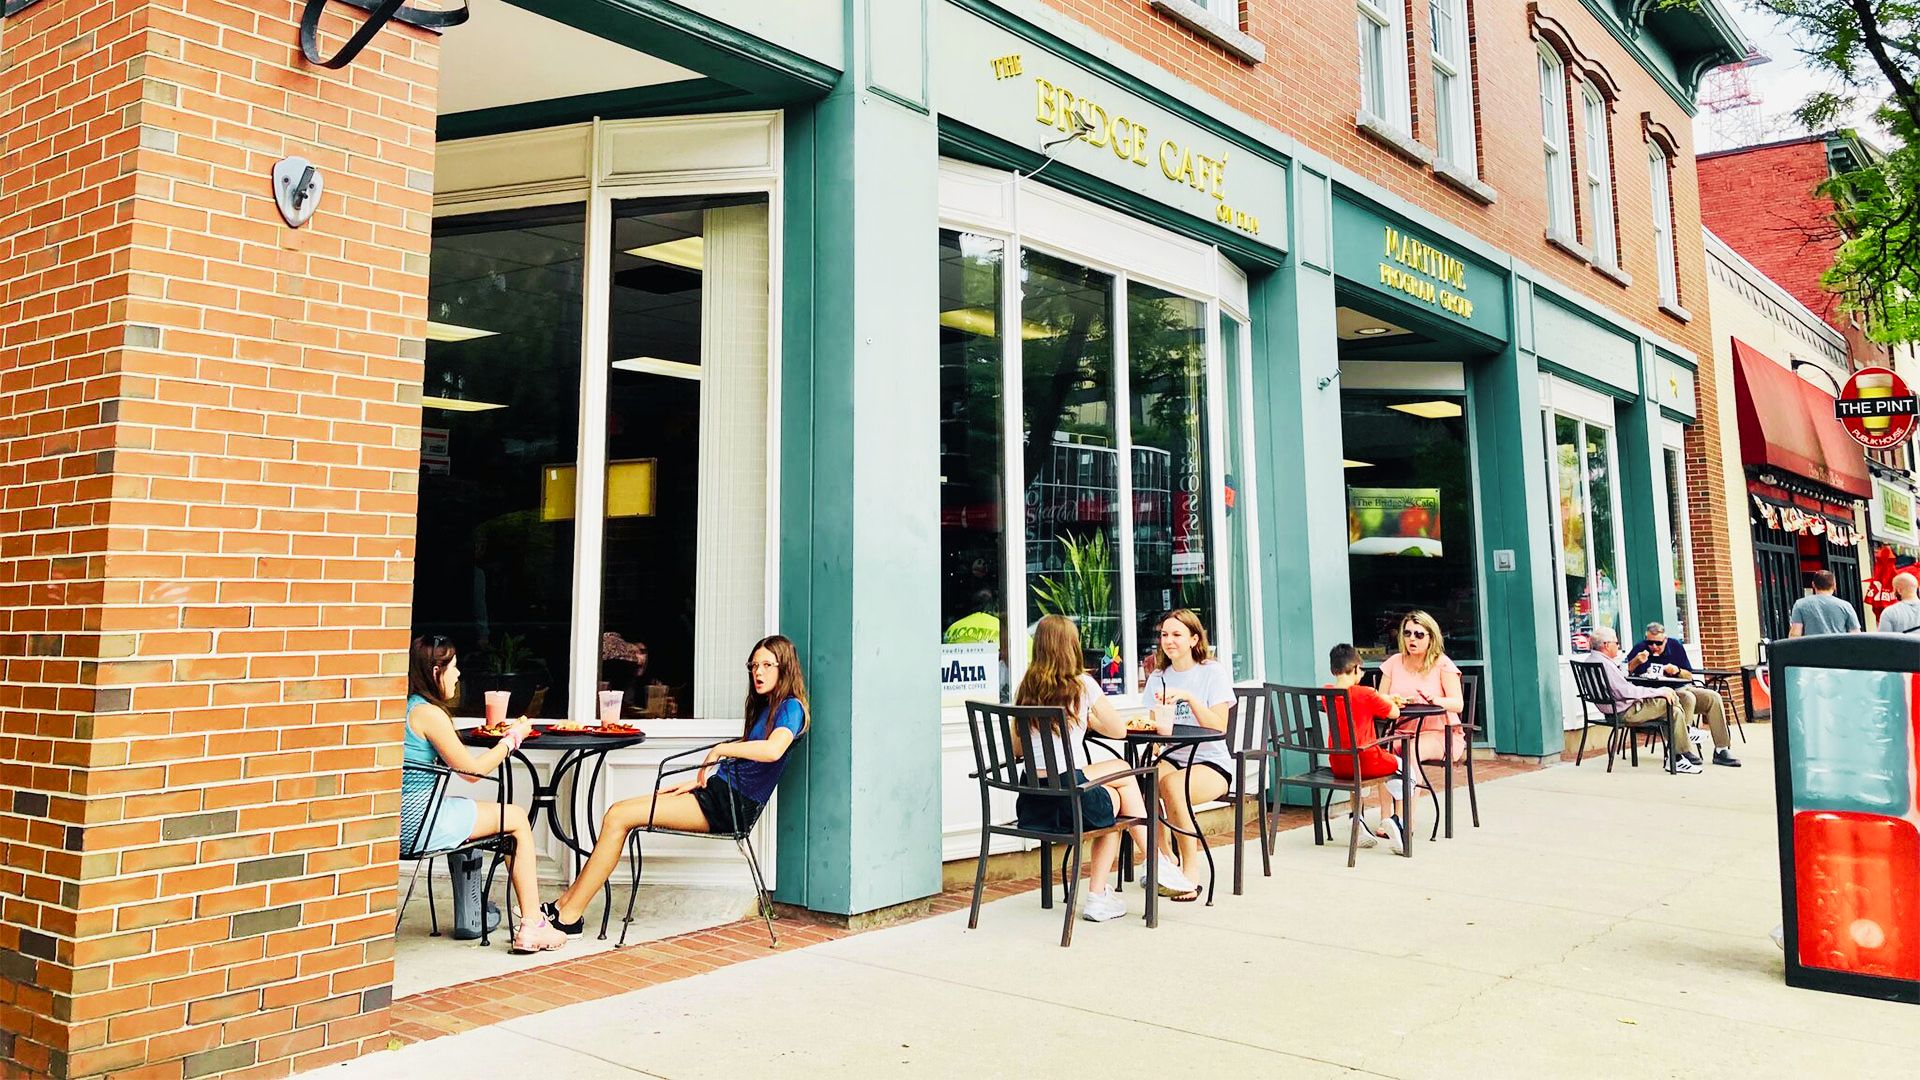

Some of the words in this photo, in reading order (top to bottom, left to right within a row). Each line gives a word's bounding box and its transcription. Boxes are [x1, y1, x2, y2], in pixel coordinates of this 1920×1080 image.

[990, 54, 1022, 80] THE
[1035, 76, 1149, 167] BRIDGE
[1159, 137, 1230, 200] CAFÉ
[1216, 204, 1232, 224] ON
[1385, 226, 1467, 291] MARITIME
[1379, 262, 1435, 304] PROGRAM
[1439, 289, 1474, 319] GROUP
[1839, 401, 1872, 415] THE
[1876, 399, 1914, 413] PINT
[1852, 429, 1878, 445] PUBLIK
[1879, 427, 1905, 445] HOUSE
[1357, 498, 1373, 507] The
[941, 660, 986, 683] VAZZA
[1652, 665, 1661, 674] 57
